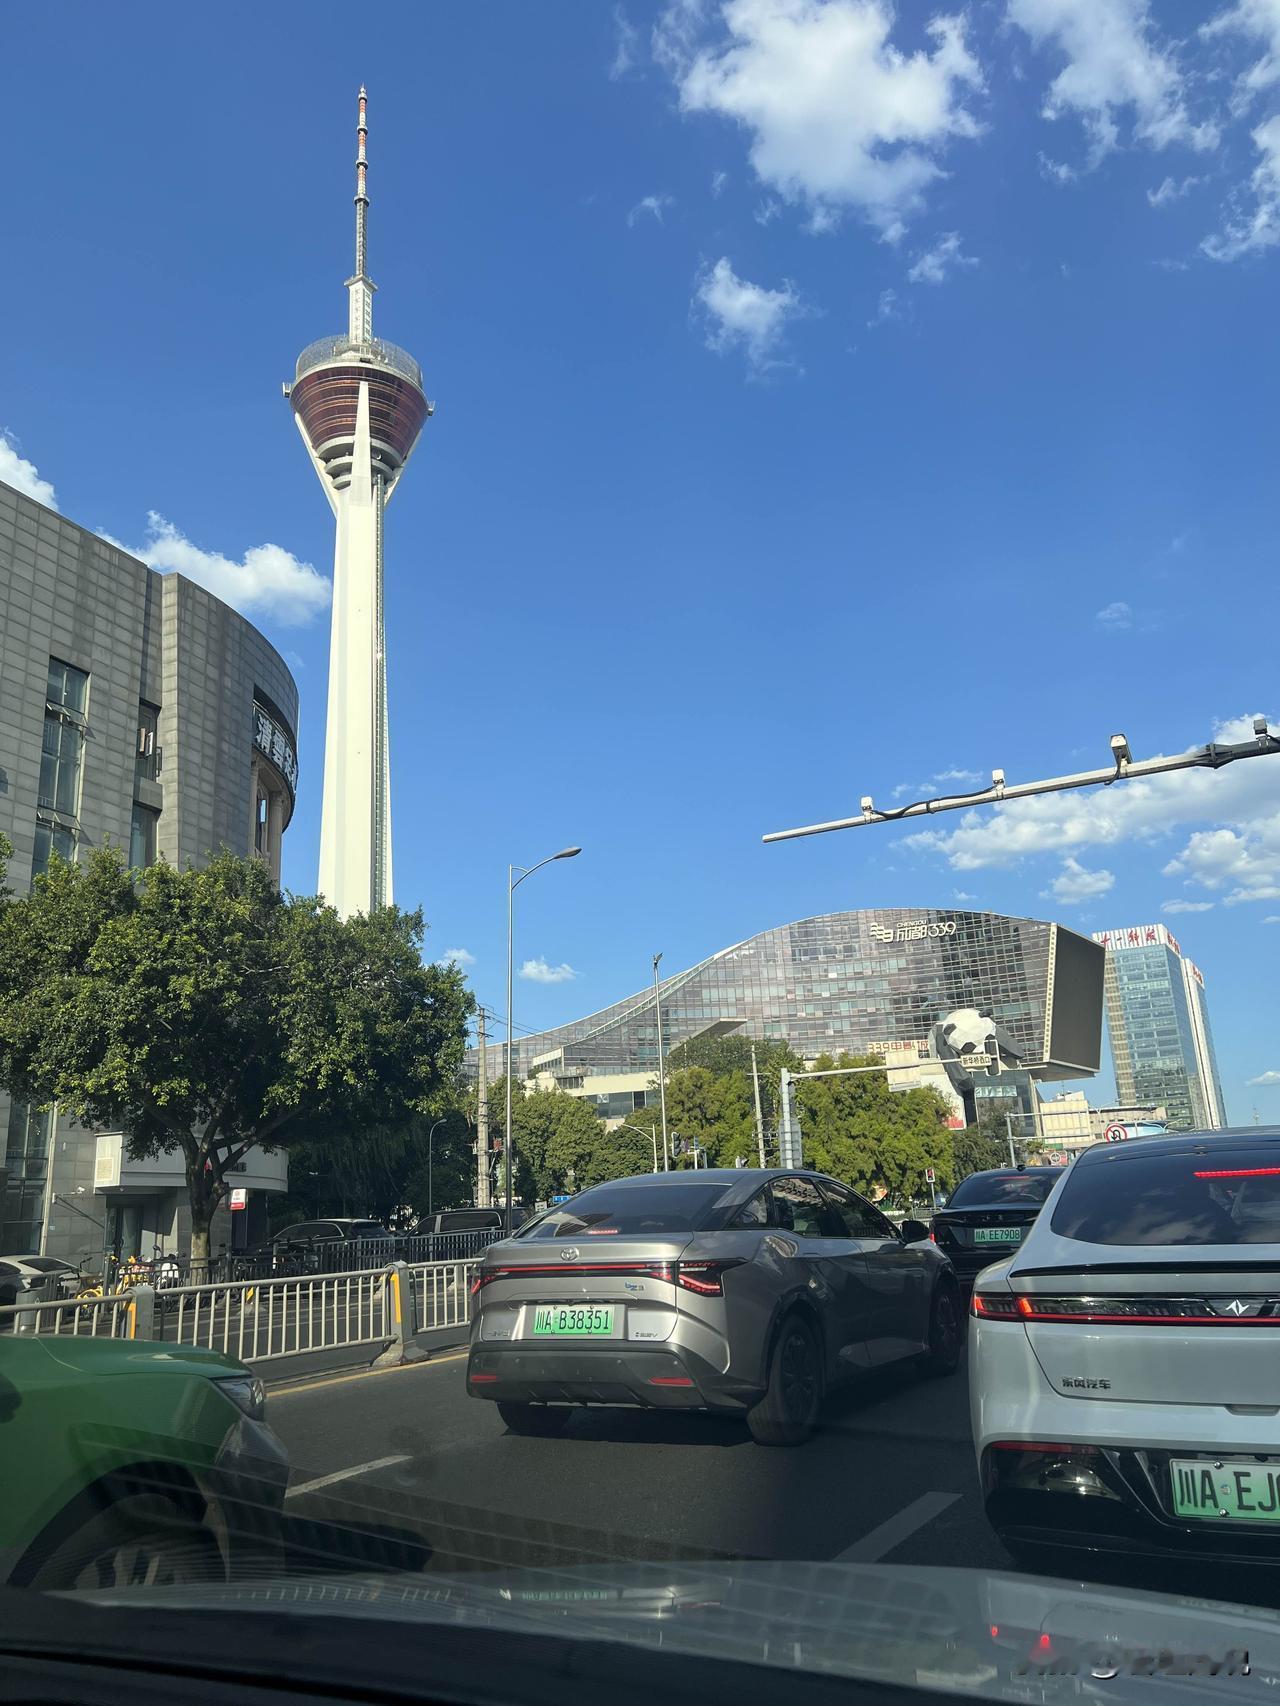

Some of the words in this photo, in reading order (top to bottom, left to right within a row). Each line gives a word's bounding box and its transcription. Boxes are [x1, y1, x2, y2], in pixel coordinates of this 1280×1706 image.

[962, 1055, 991, 1066] 新华桥西口
[1233, 1471, 1280, 1512] EJ
